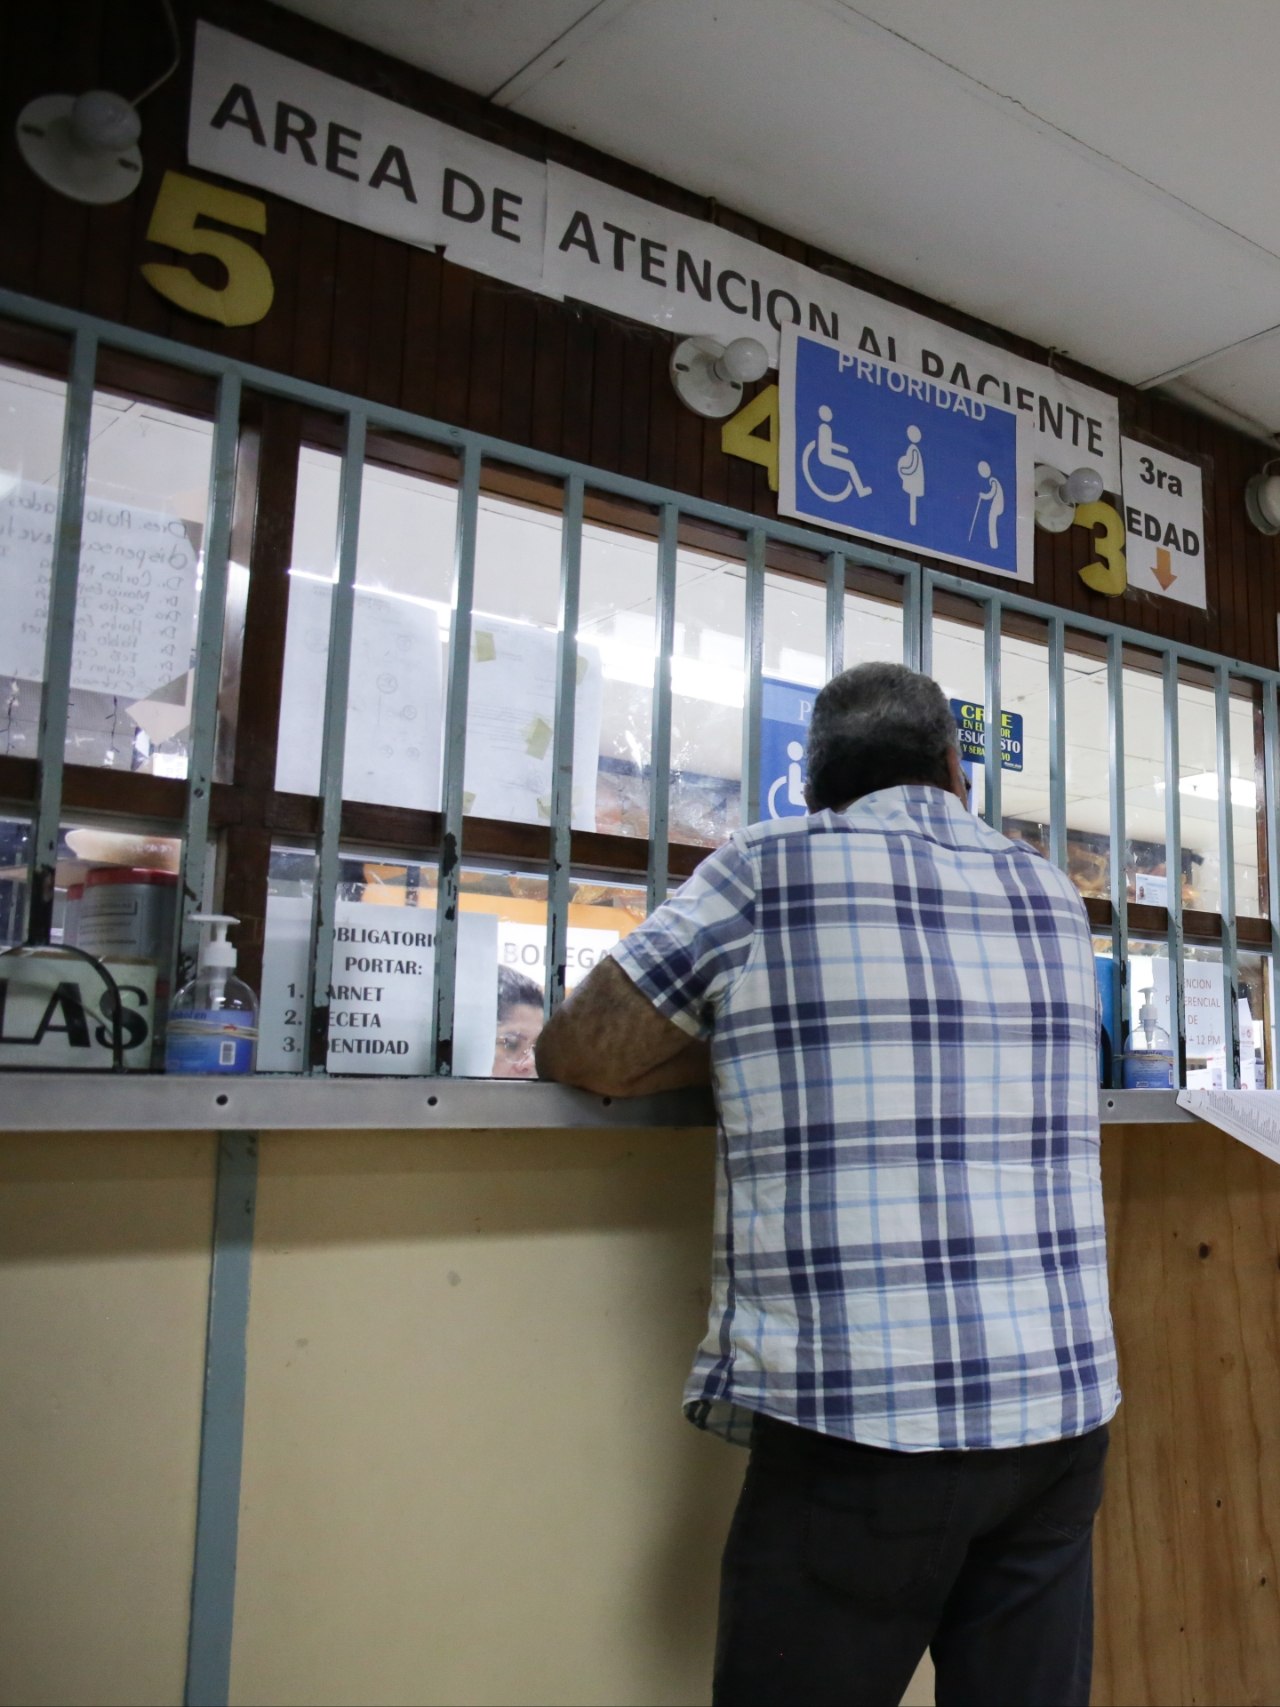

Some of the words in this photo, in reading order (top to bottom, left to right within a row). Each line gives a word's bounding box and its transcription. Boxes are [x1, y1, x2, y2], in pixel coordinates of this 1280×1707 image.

[210, 82, 418, 204] AREA
[442, 167, 523, 244] DE
[558, 210, 839, 341] ATENCION
[140, 170, 275, 328] 5
[837, 352, 987, 422] PRIORIDAD
[721, 383, 780, 493] 4
[1139, 456, 1183, 498] 3ra
[1125, 505, 1200, 557] EDAD
[1073, 499, 1127, 598] 3
[961, 704, 1013, 729] CRE
[333, 927, 437, 948] BLIGATORI
[345, 956, 423, 976] PORTAR:
[503, 942, 610, 969] BOEGA
[287, 983, 304, 999] 1.
[328, 984, 385, 1002] ARNET
[284, 1010, 302, 1025] 2.
[329, 1011, 381, 1028] ECETA
[1187, 1014, 1199, 1025] DE
[282, 1036, 301, 1053] 3.
[328, 1038, 409, 1055] ENTIDAD
